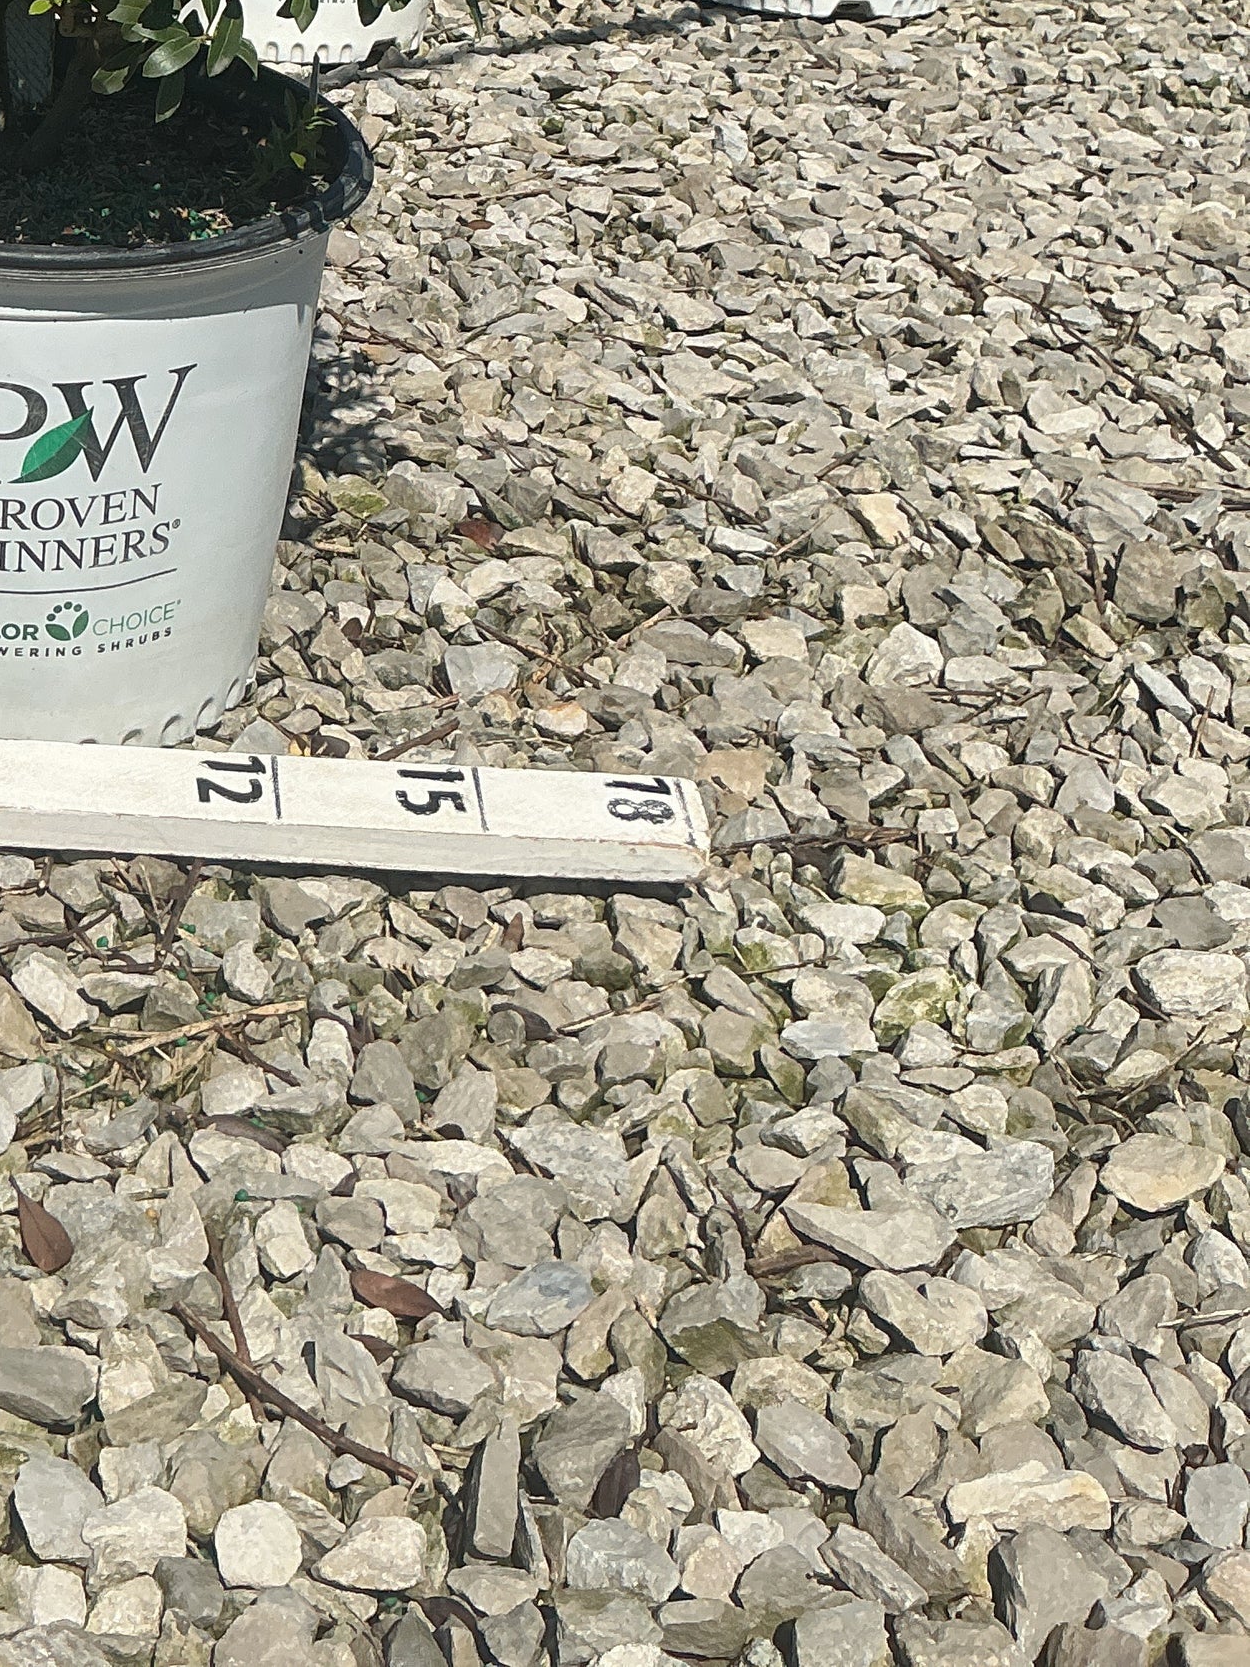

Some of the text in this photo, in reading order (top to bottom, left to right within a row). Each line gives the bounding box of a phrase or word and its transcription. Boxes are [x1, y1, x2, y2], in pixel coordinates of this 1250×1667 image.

[97, 626, 173, 654] SHRUBS
[196, 755, 267, 804] 12
[396, 768, 467, 816] 15
[604, 777, 676, 825] 18
